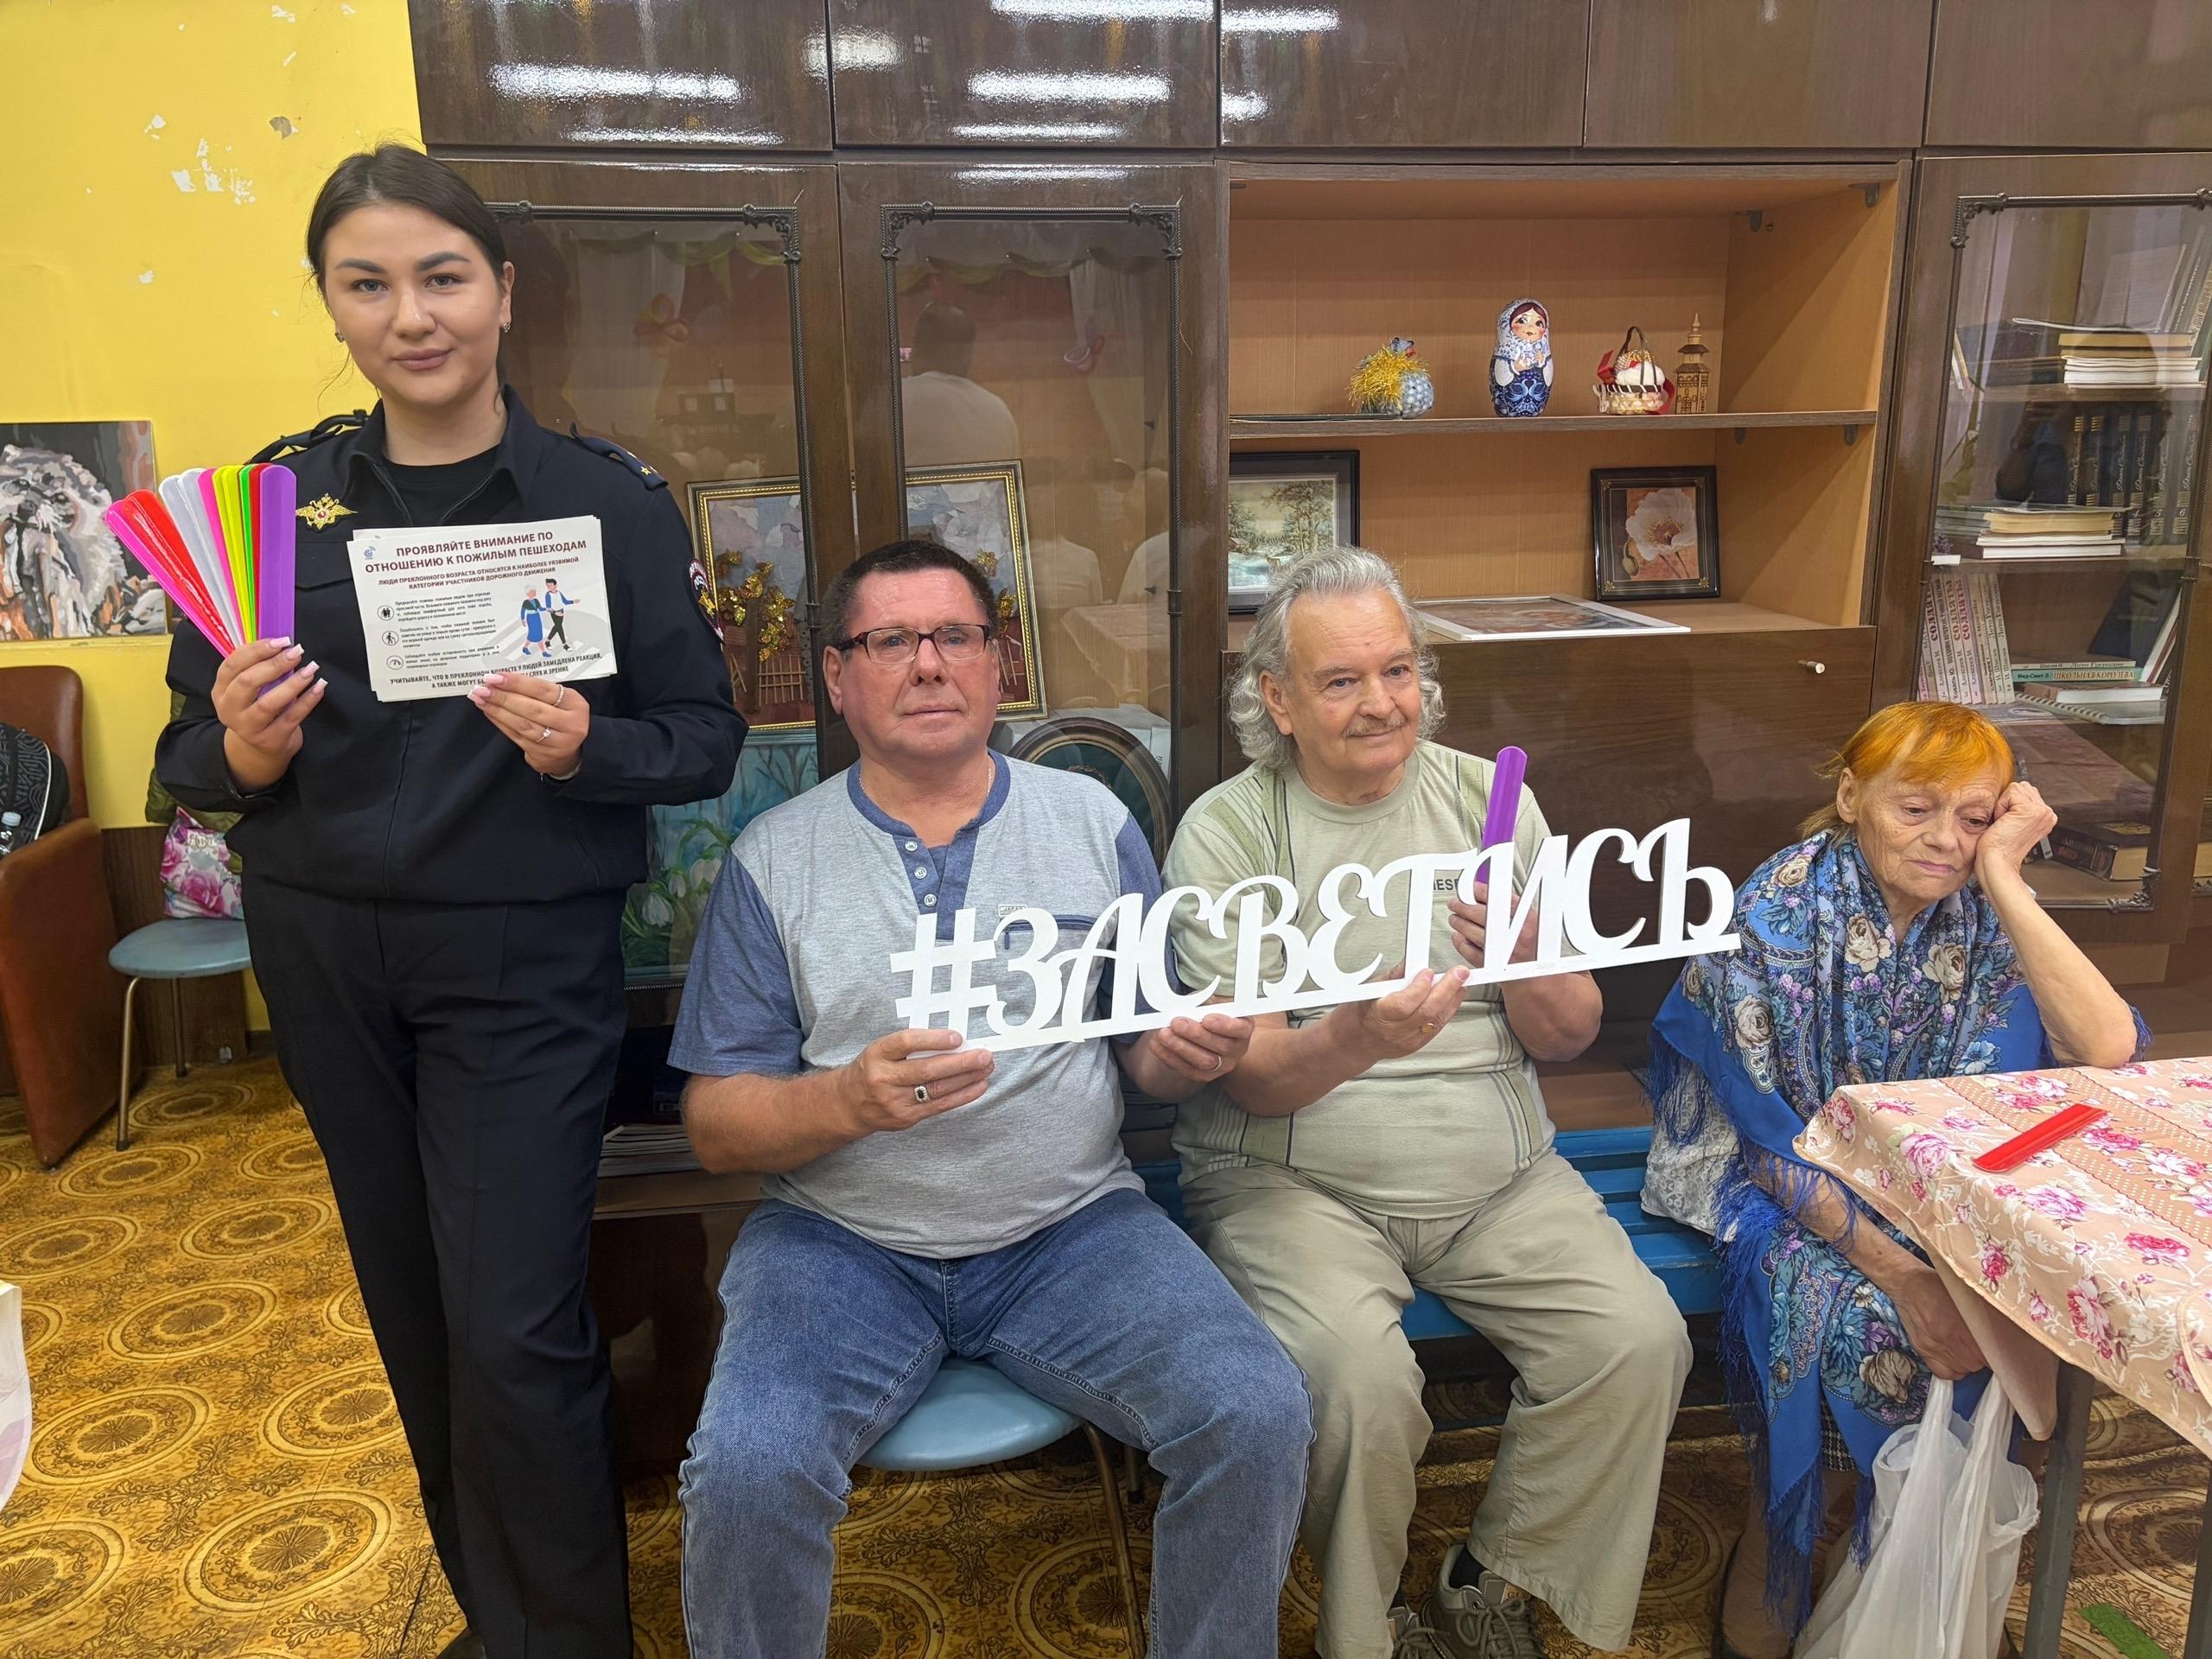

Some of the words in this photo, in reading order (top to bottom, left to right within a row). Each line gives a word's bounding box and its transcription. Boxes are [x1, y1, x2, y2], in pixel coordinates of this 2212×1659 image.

[365, 557, 443, 573] ОТНОШЕНИЮ
[446, 556, 454, 565] К
[456, 549, 517, 564] ПОЖИЛЫМ
[519, 540, 587, 556] ПЕШЕХОДАМ
[397, 541, 472, 556] ПРОЯВЛЯЙТЕ
[474, 533, 536, 549] ВНИМАНИЕ
[537, 531, 553, 541] ПО
[399, 574, 445, 583] ПРЕКЛОННОГО
[476, 565, 512, 575] ОТНОСЯТСЯ
[517, 561, 547, 569] НАИБОЛЕЕ
[548, 556, 580, 566] УЯЗВИМОЙ
[445, 575, 485, 586] УЧАСТНИКОВ
[486, 571, 523, 582] ДОРОЖНОГО
[524, 567, 556, 576] ДВИЖЕНИЯ
[390, 676, 432, 684] УЧИТЫВАЙТЕ,
[523, 662, 542, 671] ЛЮДЕЙ
[543, 658, 576, 667] ЗАМЕДЛЕНА
[576, 652, 603, 662] РЕАКЦИЯ,
[2095, 671, 2133, 679] КОРОЛЕВА
[889, 817, 1742, 1047] #ЗАСВЕТИСЬ
